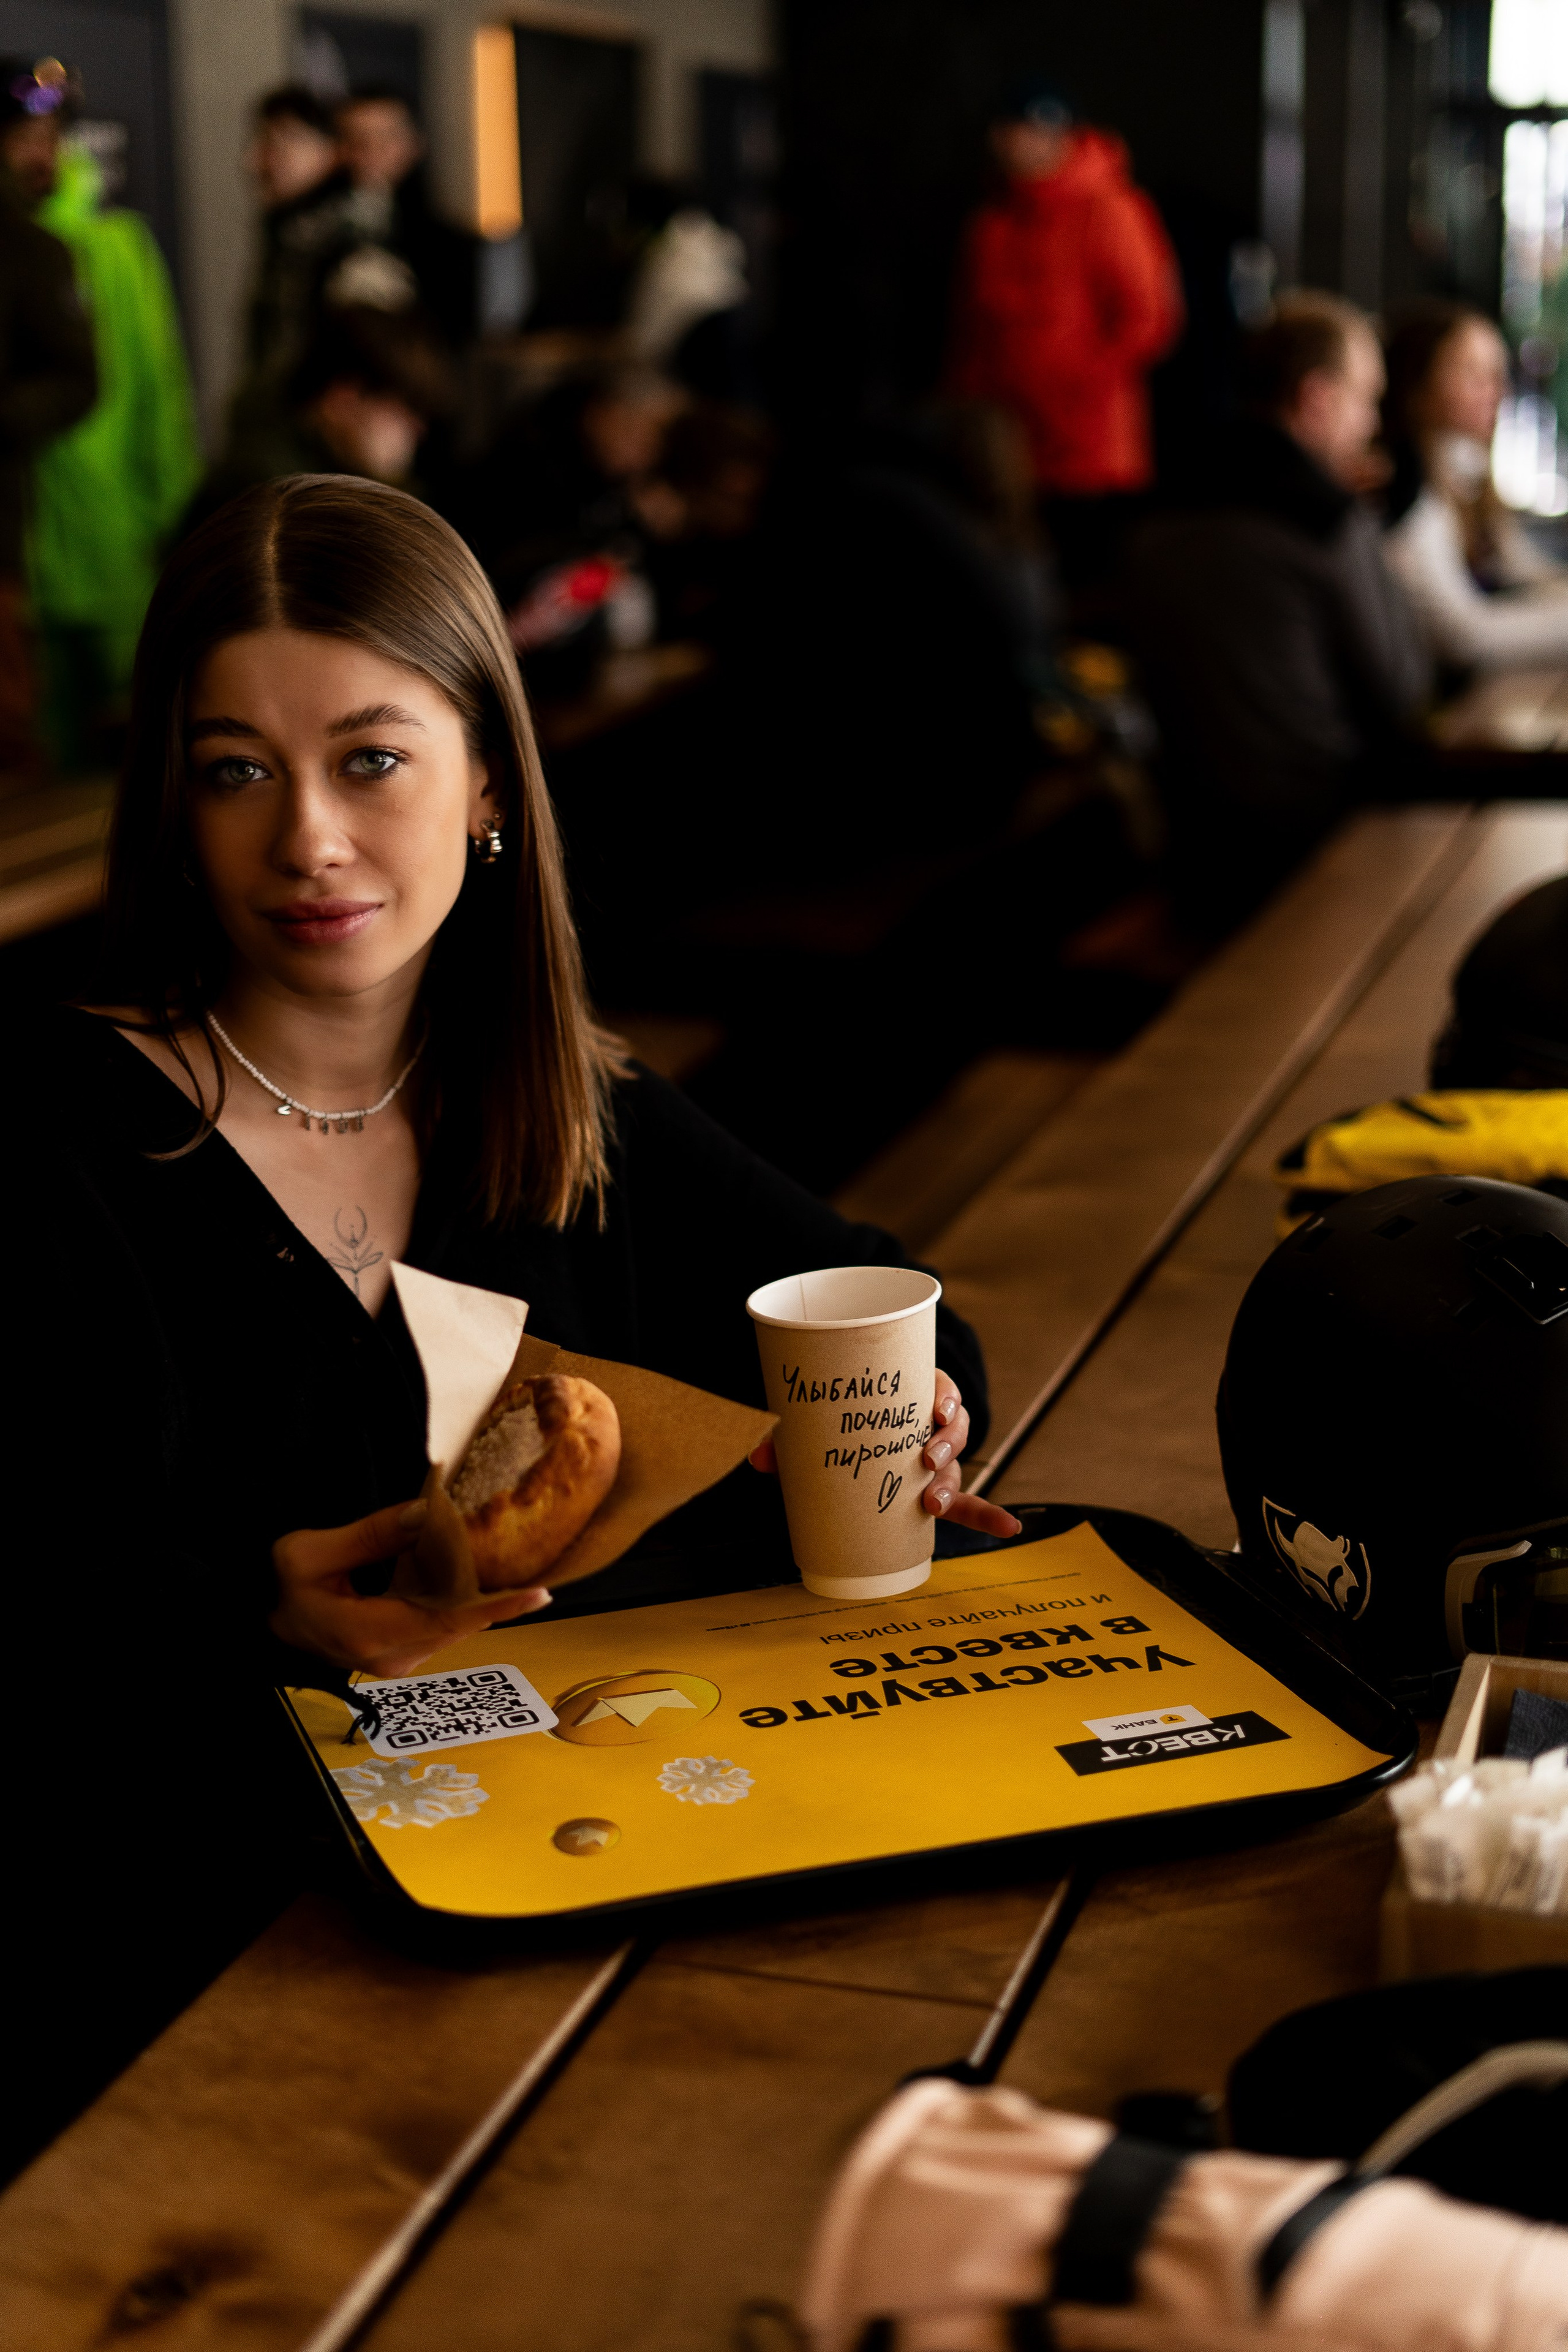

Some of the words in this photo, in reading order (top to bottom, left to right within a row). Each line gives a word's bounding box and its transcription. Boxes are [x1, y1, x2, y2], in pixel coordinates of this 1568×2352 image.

[1090, 1594, 1112, 1604] и
[927, 1598, 1087, 1628] получайте
[1099, 1615, 1153, 1635] в
[819, 1621, 922, 1645] призы
[829, 1624, 1096, 1679] квесте
[738, 1645, 1197, 1729] Участвуйте
[1110, 1719, 1158, 1731] БАНК
[1101, 1724, 1246, 1762] КВЕСТ
